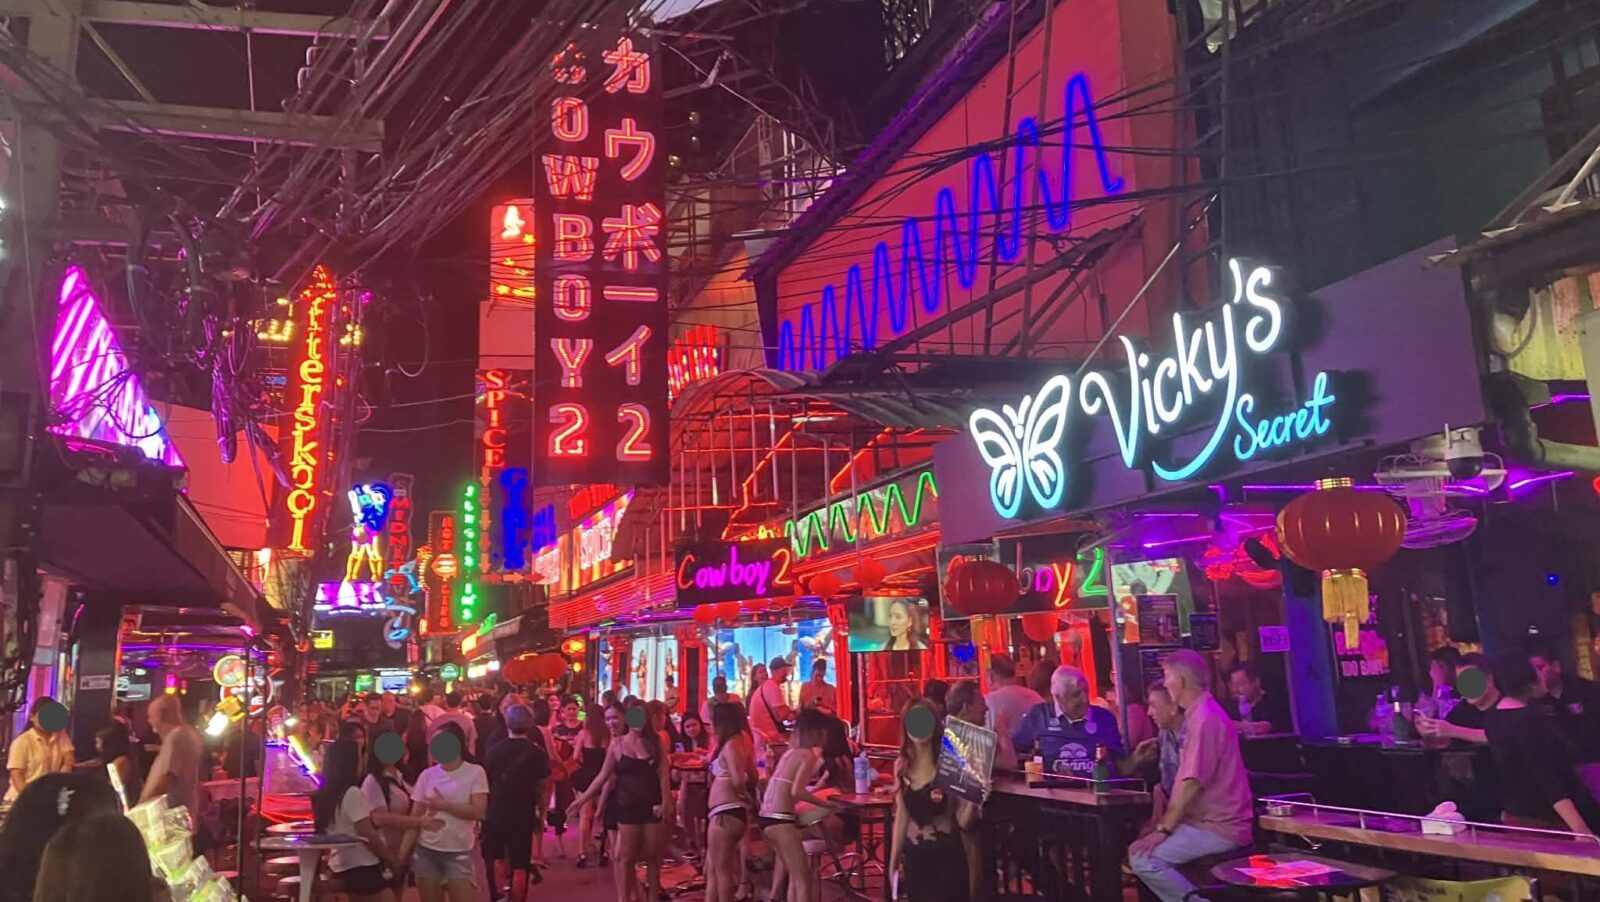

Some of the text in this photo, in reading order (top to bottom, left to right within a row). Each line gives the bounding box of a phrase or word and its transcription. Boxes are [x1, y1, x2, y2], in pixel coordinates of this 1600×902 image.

[1080, 257, 1283, 481] Vicky's
[482, 369, 506, 467] SPICE
[1235, 371, 1335, 460] Secret
[677, 545, 792, 596] Cowboy 2
[1076, 547, 1108, 597] 2
